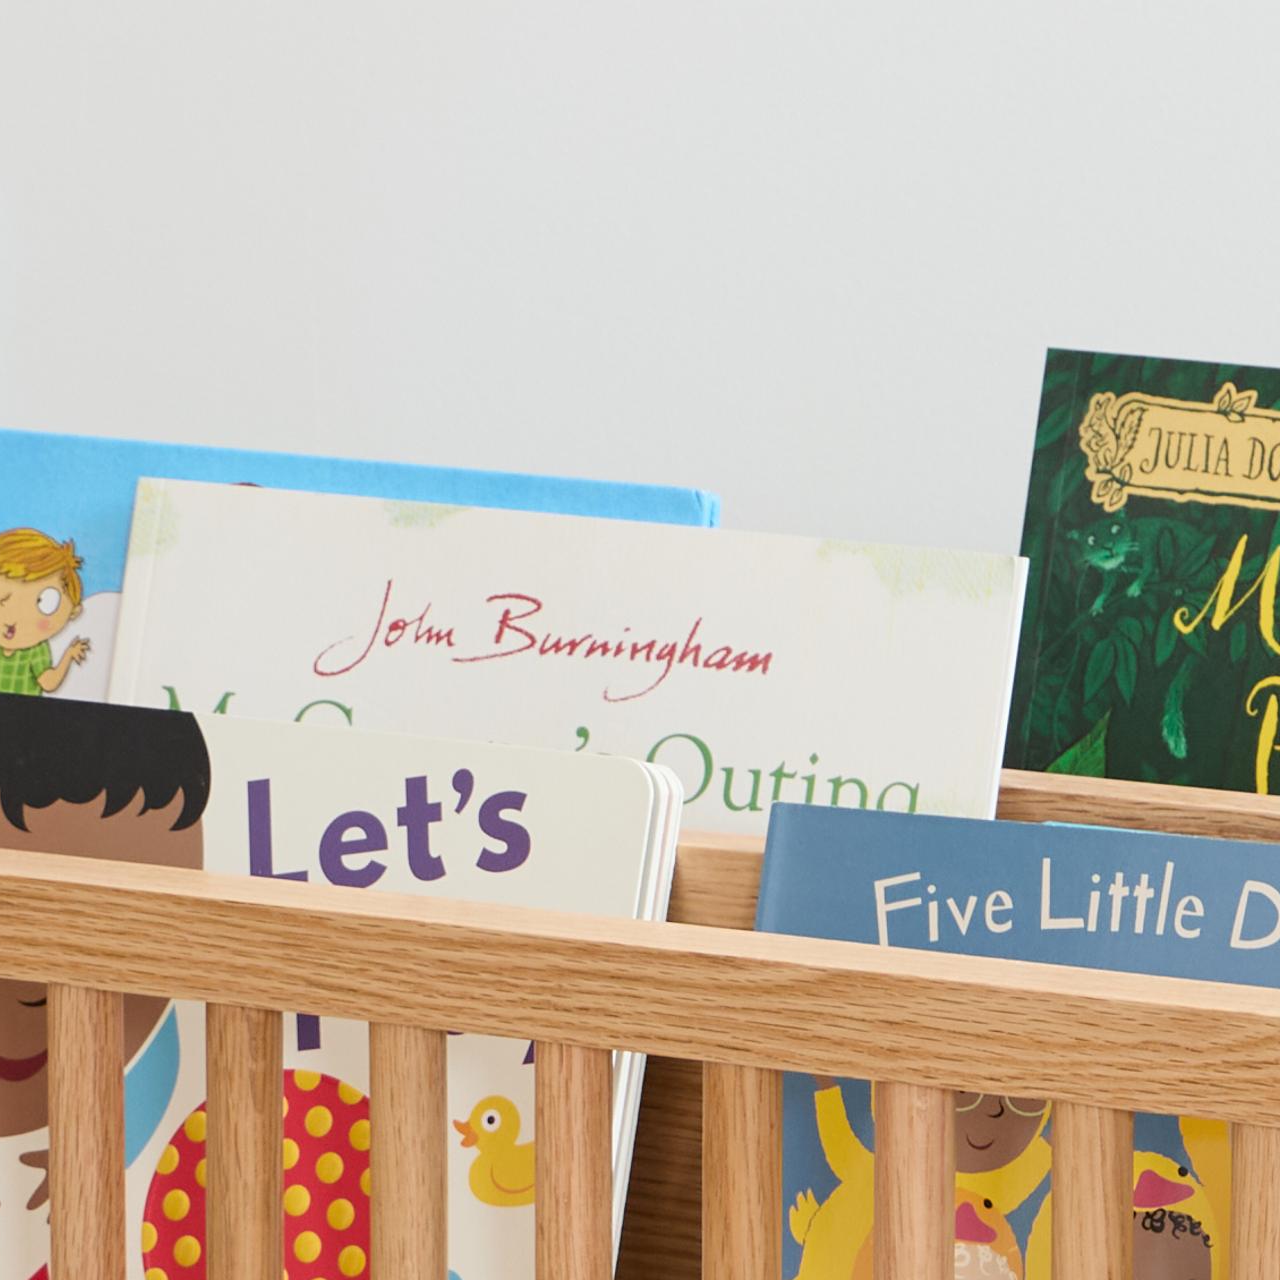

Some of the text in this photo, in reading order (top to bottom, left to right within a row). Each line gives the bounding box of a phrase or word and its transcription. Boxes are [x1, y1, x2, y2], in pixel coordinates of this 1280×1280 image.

[1140, 427, 1233, 477] JULIA
[314, 579, 775, 704] John Burningham
[247, 767, 531, 889] Let's
[873, 870, 1013, 947] Five
[1040, 857, 1206, 939] Little
